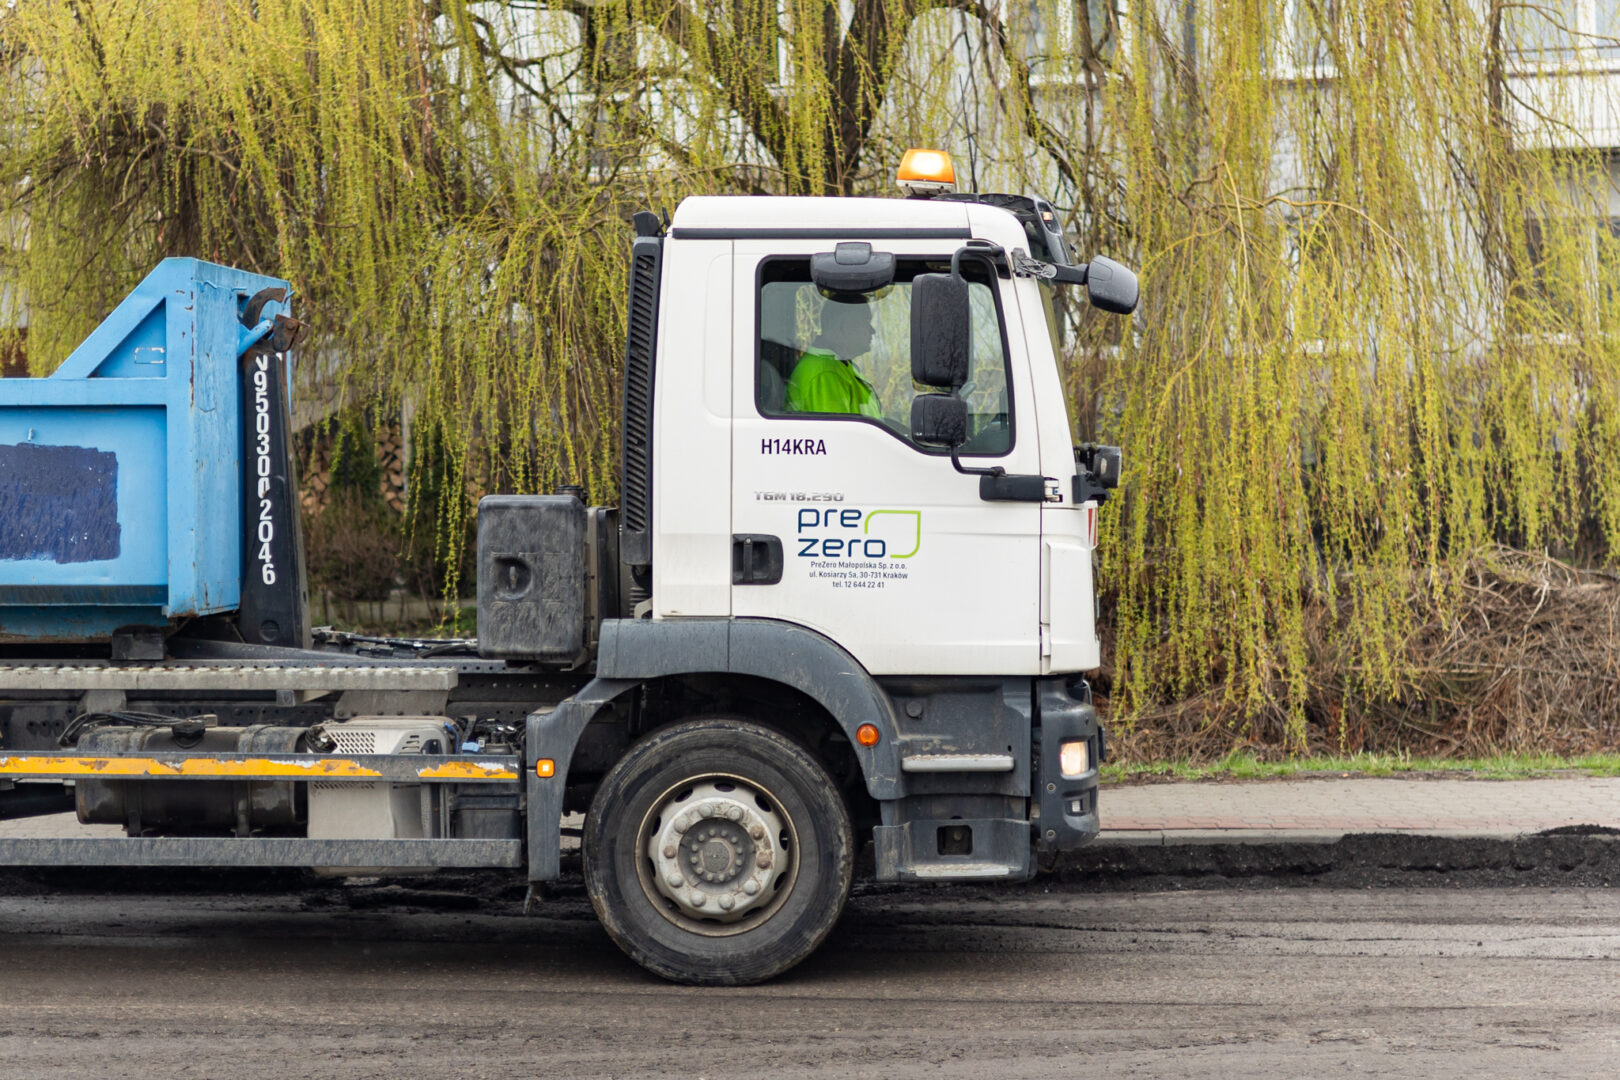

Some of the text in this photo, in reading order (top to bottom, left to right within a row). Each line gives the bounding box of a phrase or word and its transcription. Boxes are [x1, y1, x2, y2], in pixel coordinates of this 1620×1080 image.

[761, 438, 827, 455] H14KRA
[754, 491, 845, 502] TGM 18.290
[797, 508, 862, 534] pre
[797, 538, 886, 558] zero
[810, 561, 837, 569] PreZero
[838, 561, 877, 570] Małopolska
[878, 561, 889, 570] Sp.
[819, 571, 847, 580] Kosiarzy
[848, 571, 858, 580] 5a,
[860, 571, 881, 579] 30-731
[883, 571, 908, 580] Kraków
[867, 581, 875, 589] 22
[877, 581, 884, 589] 41
